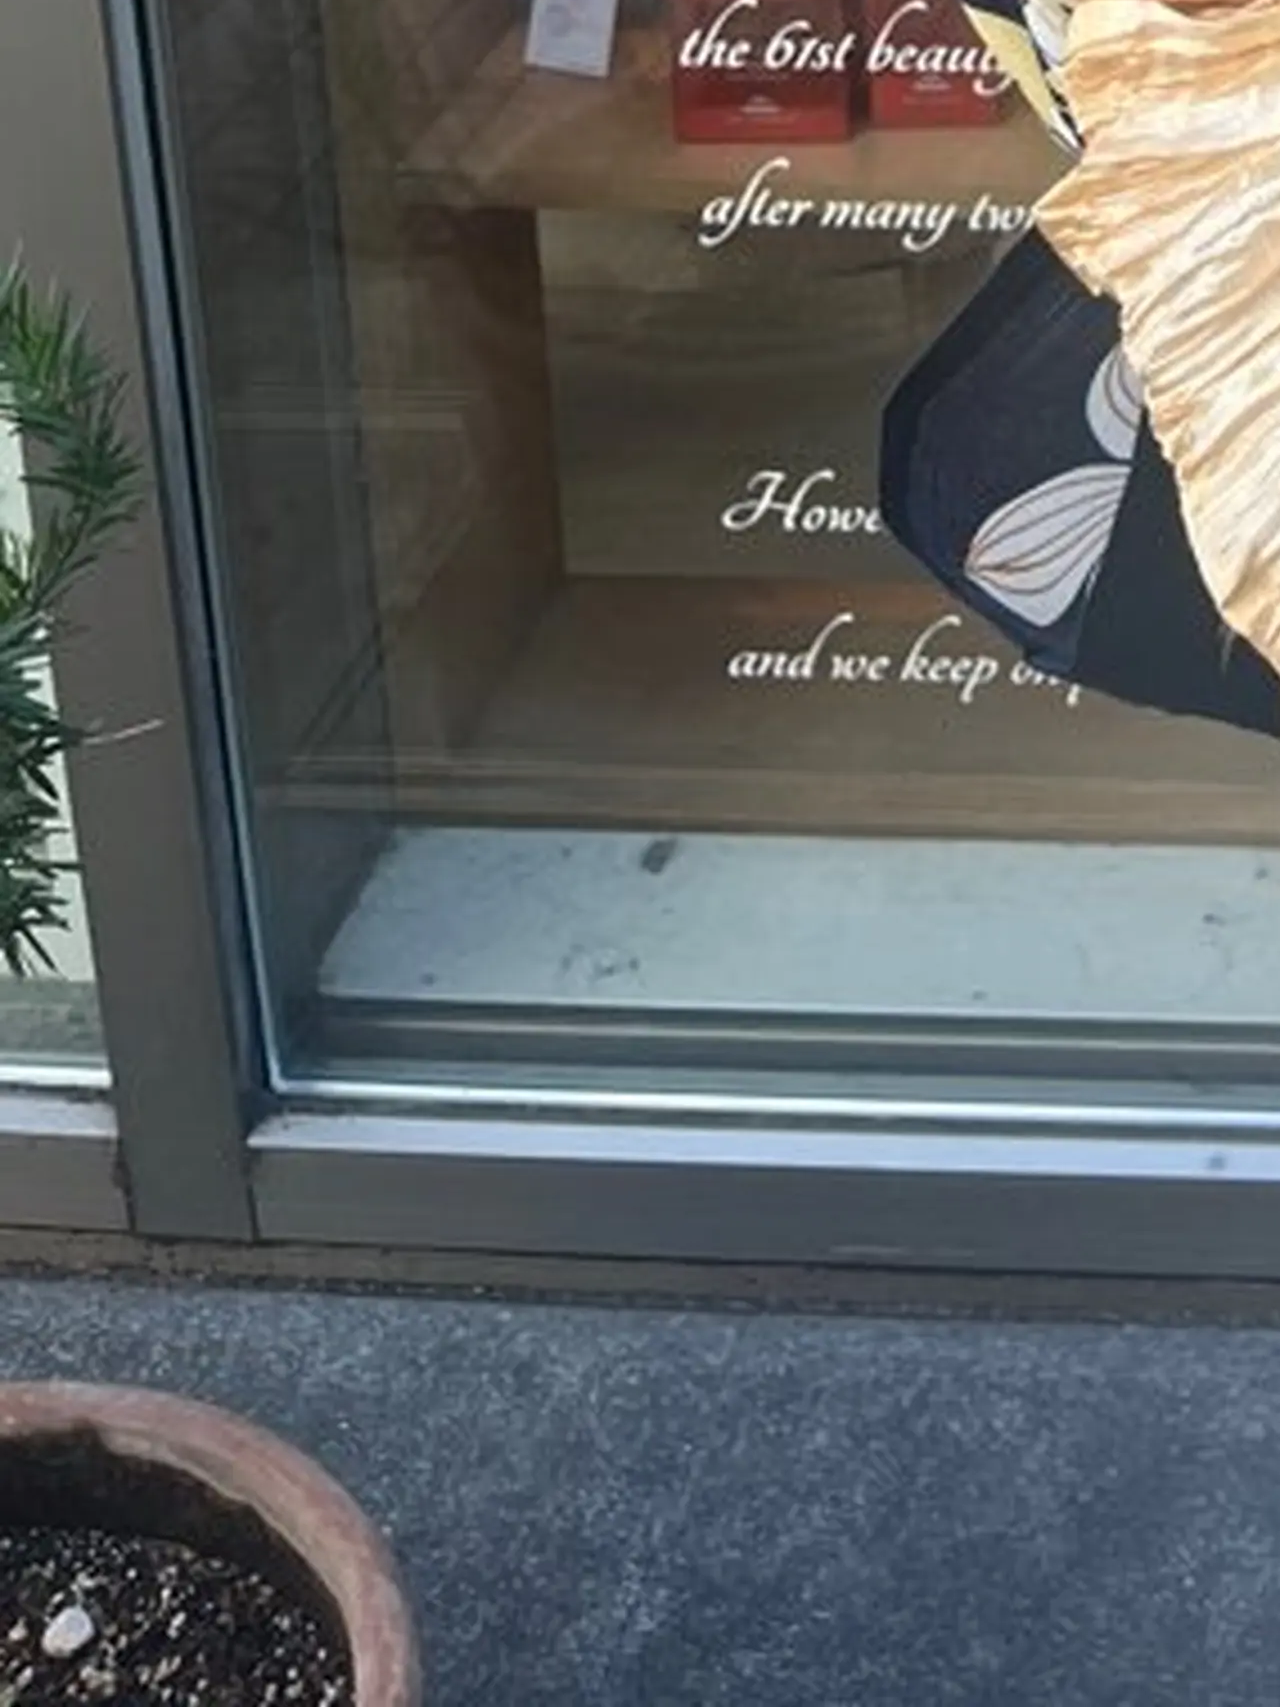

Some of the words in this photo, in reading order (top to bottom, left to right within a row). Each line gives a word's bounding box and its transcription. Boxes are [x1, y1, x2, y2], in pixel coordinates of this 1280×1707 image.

[765, 21, 856, 73] 61st
[700, 158, 813, 246] after
[821, 198, 956, 253] many
[728, 613, 853, 679] and
[831, 649, 887, 681] we
[901, 617, 998, 703] keep
